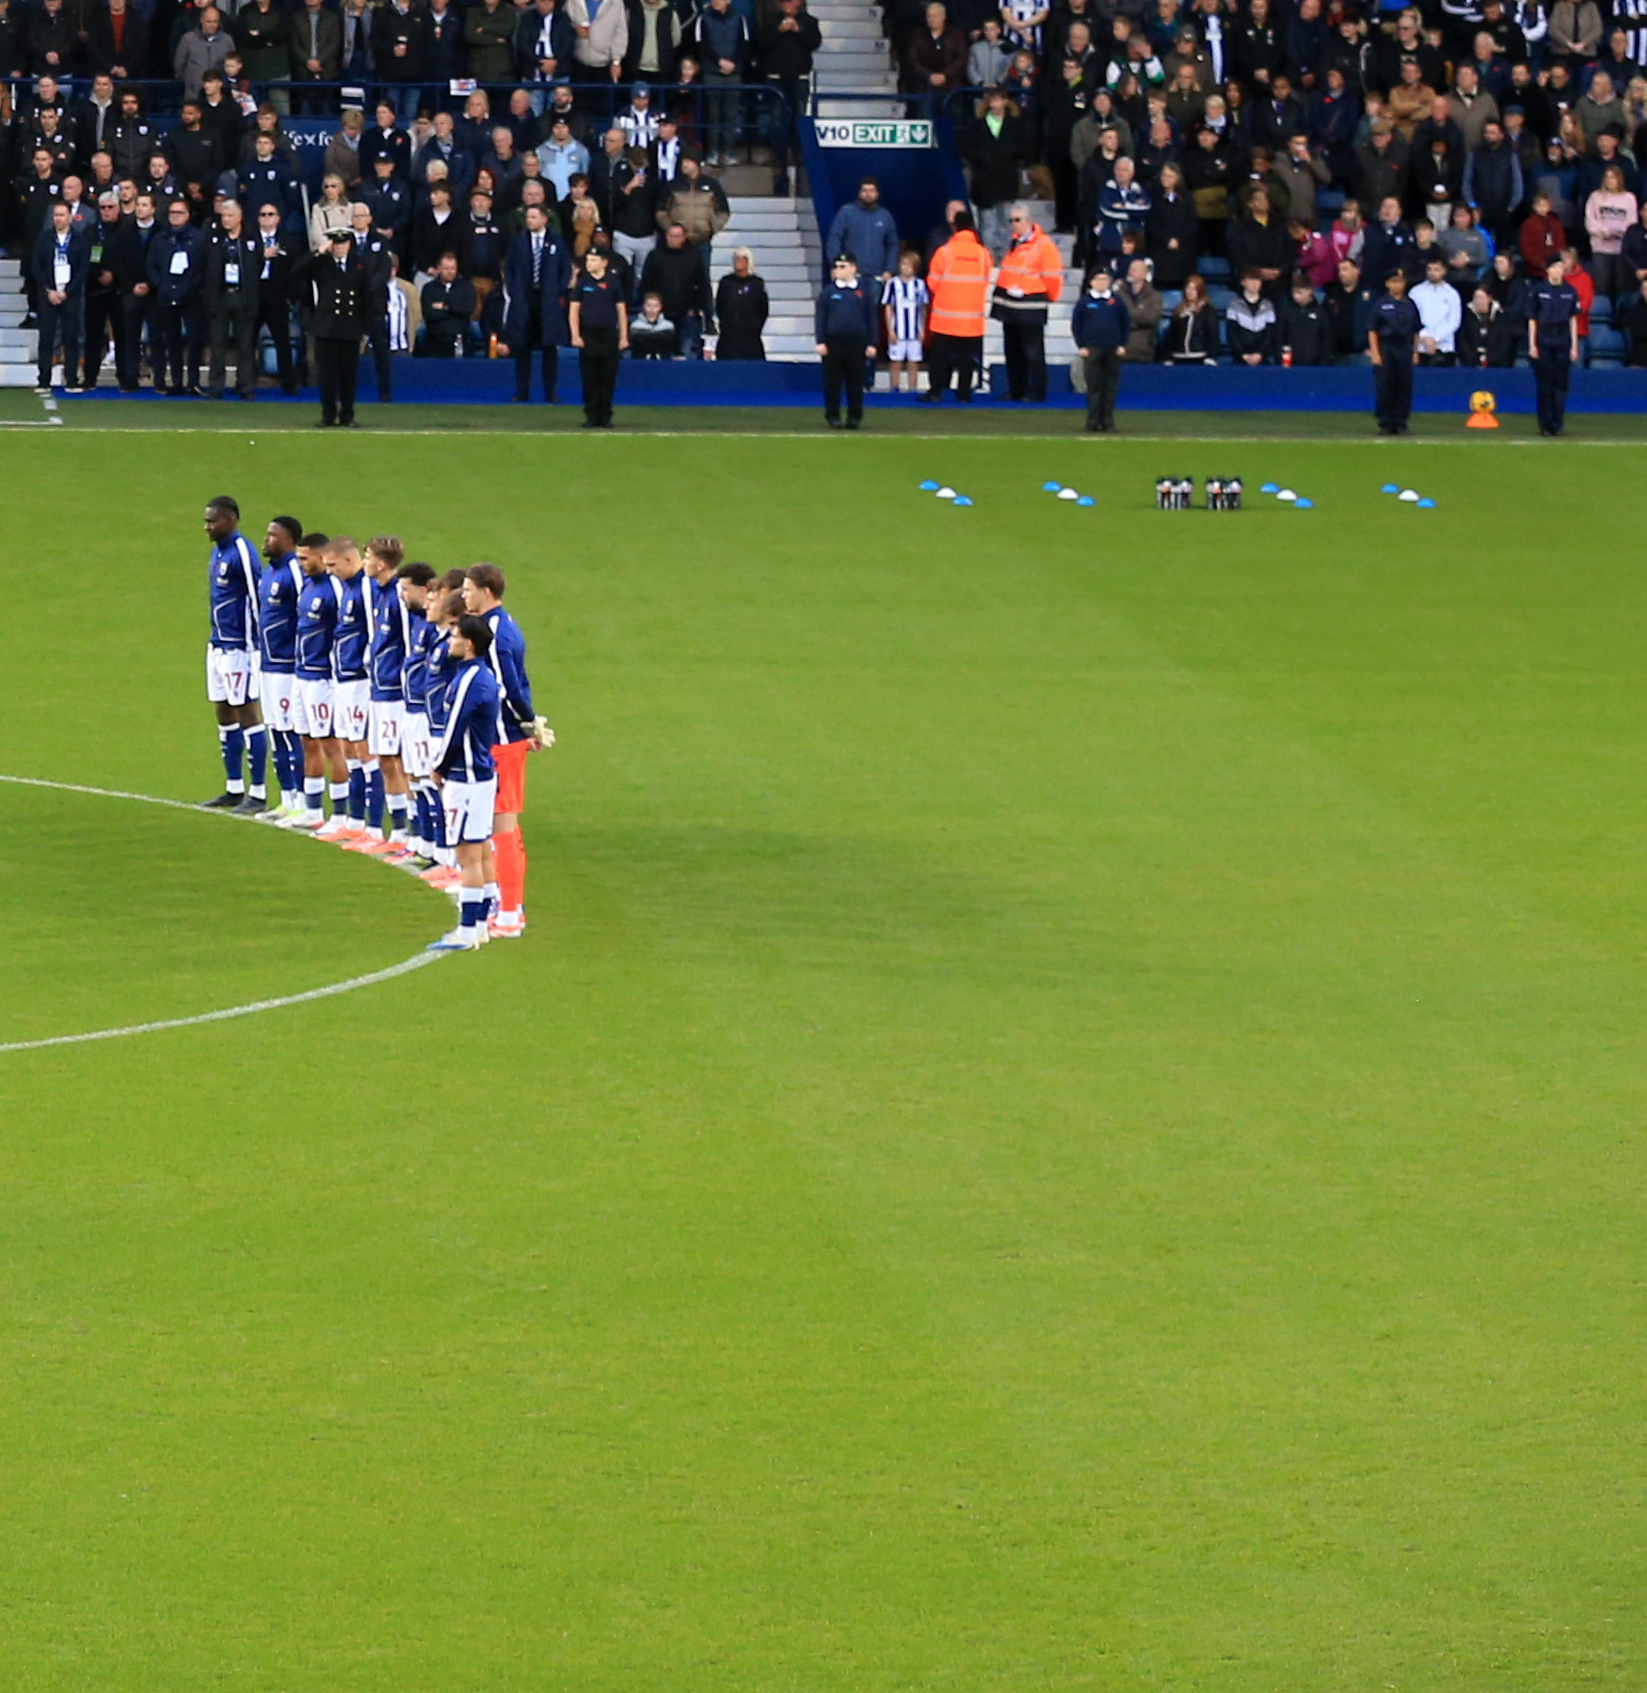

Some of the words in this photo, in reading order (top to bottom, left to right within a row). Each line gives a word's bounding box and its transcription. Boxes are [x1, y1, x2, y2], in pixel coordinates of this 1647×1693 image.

[817, 126, 849, 140] V10
[856, 125, 894, 141] EXIT
[224, 672, 243, 687] 17
[279, 698, 290, 714] 9
[311, 703, 329, 719] 10
[348, 706, 364, 722] 14
[383, 720, 397, 738] 21
[415, 741, 428, 757] 11
